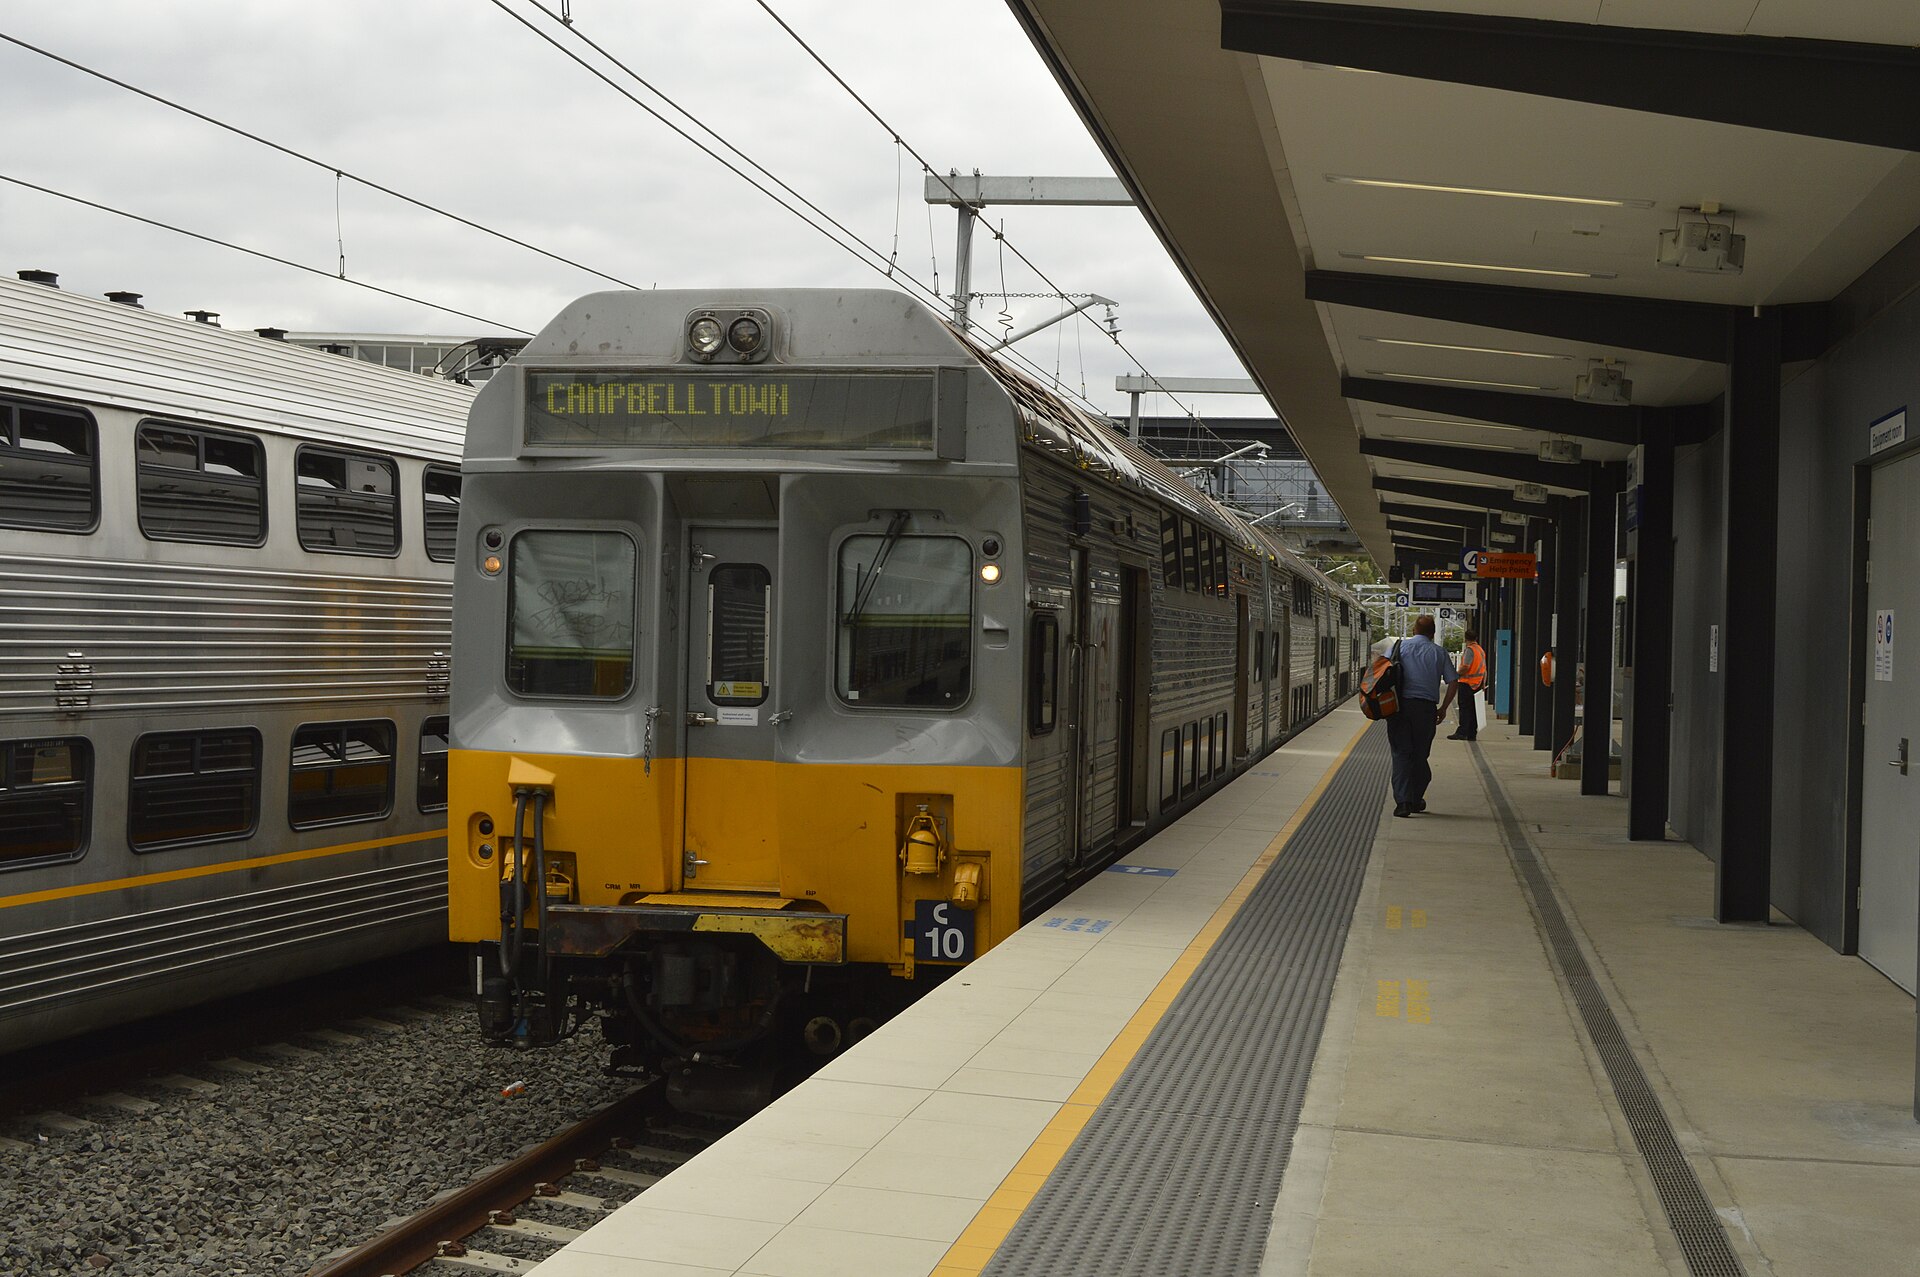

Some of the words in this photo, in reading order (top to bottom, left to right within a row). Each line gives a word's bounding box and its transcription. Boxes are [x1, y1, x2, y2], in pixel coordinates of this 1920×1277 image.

[547, 383, 789, 416] CAMPBELLTOWN
[1872, 428, 1891, 451] Equipment
[1892, 424, 1902, 440] room
[1489, 557, 1533, 566] Emergency
[1489, 566, 1507, 575] Help
[1508, 566, 1530, 574] Point
[933, 902, 948, 925] C
[924, 927, 965, 959] 10
